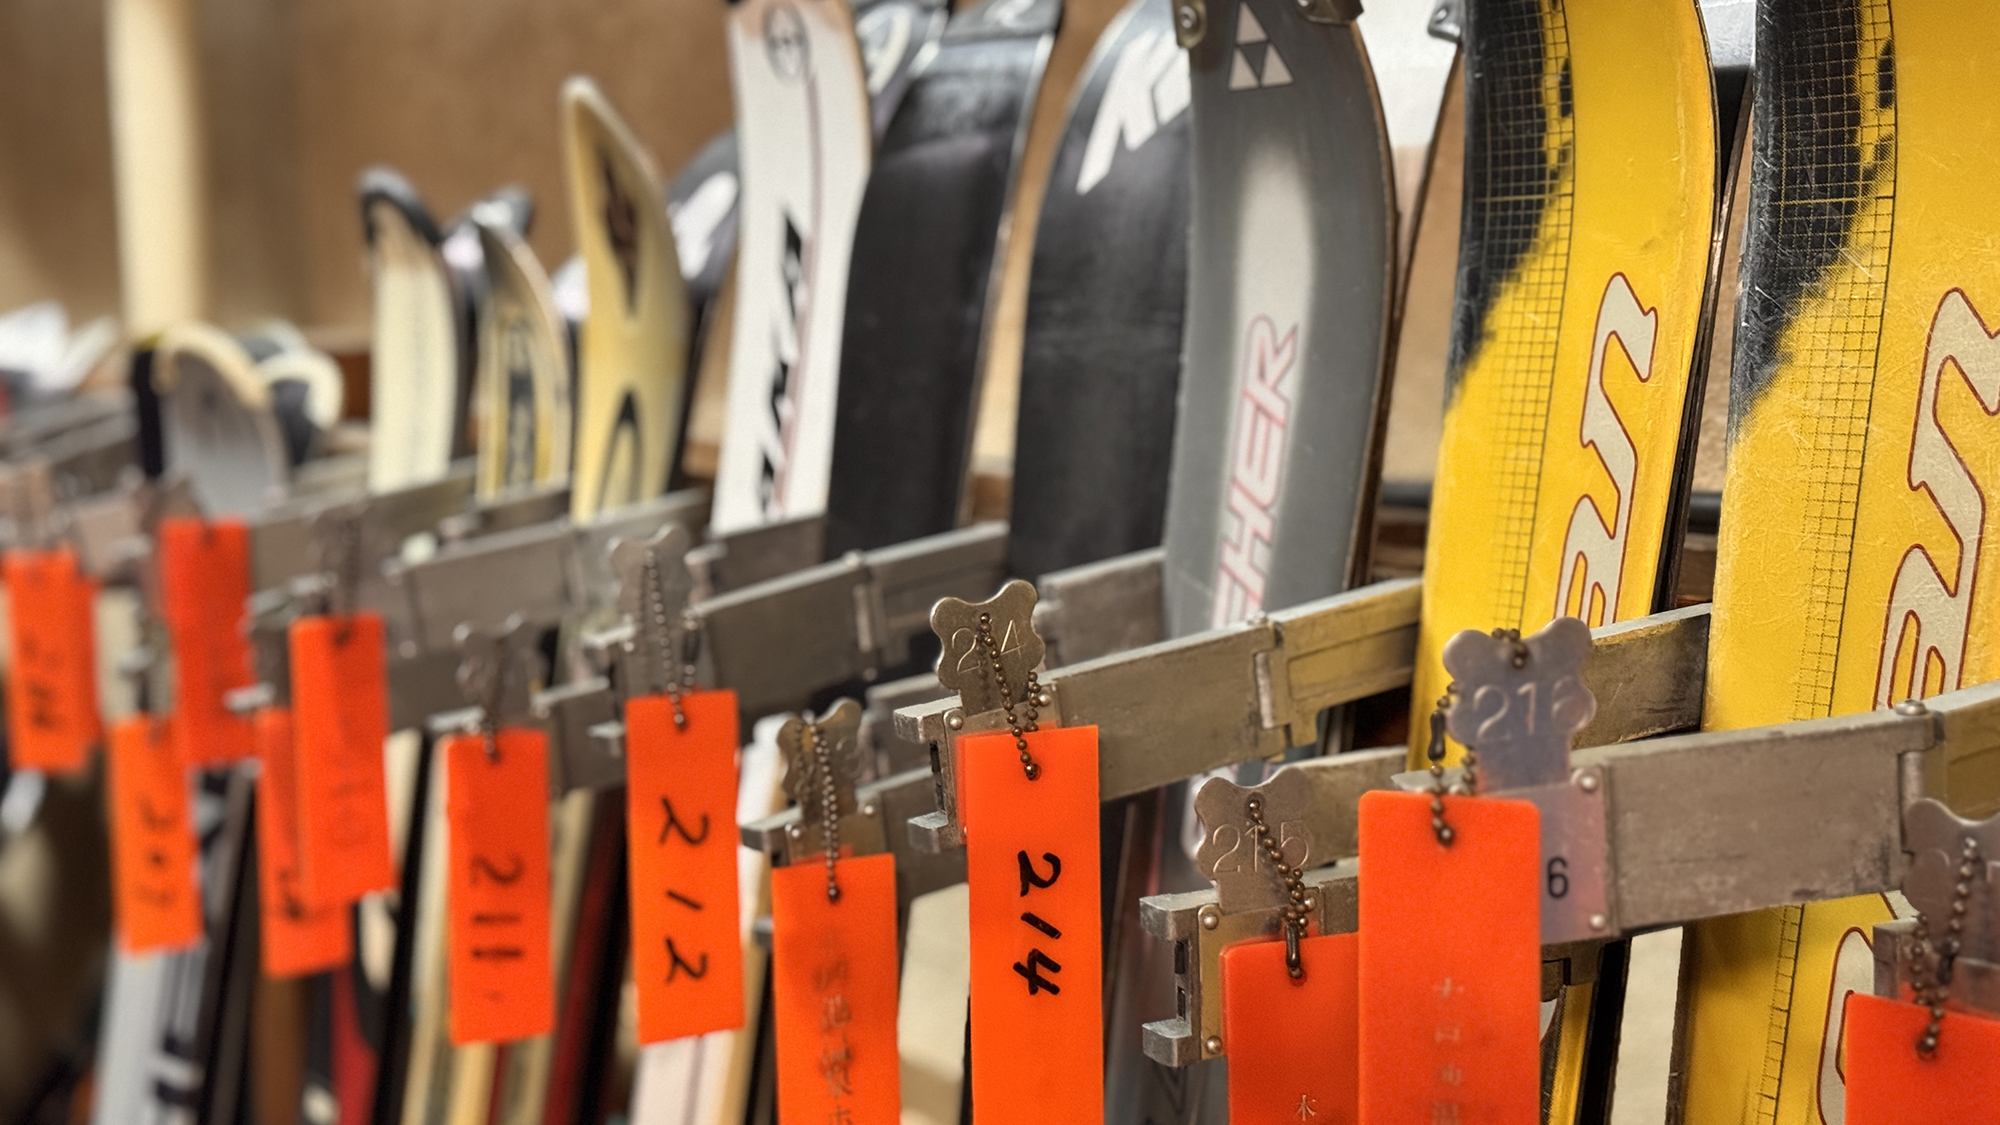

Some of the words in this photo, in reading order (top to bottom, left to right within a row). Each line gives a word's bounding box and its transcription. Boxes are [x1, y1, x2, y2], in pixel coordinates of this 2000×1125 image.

[951, 618, 1027, 674] 24
[1472, 676, 1597, 743] 216
[1212, 819, 1311, 875] 215
[660, 796, 709, 984] 212
[1012, 849, 1062, 997] 214
